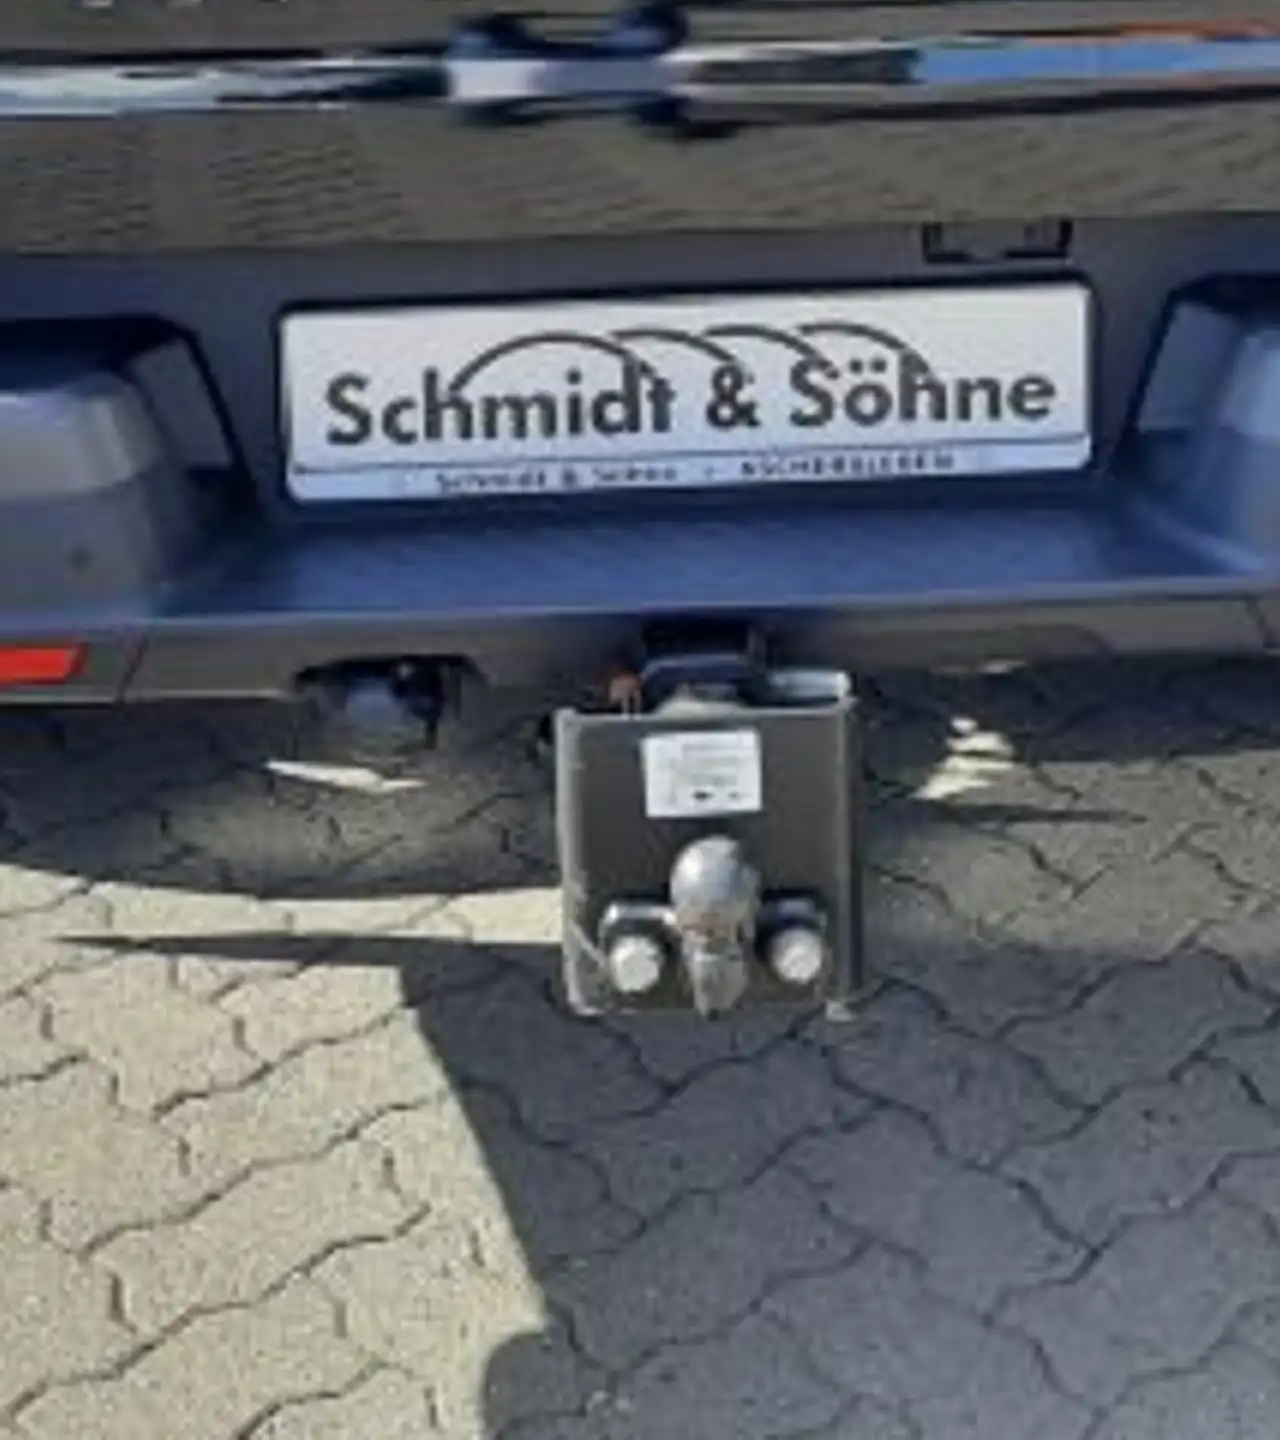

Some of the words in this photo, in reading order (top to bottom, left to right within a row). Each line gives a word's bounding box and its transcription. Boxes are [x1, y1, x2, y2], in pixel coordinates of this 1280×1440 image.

[326, 358, 675, 445] Schmidt
[705, 361, 761, 429] &
[789, 350, 1055, 428] Söhne
